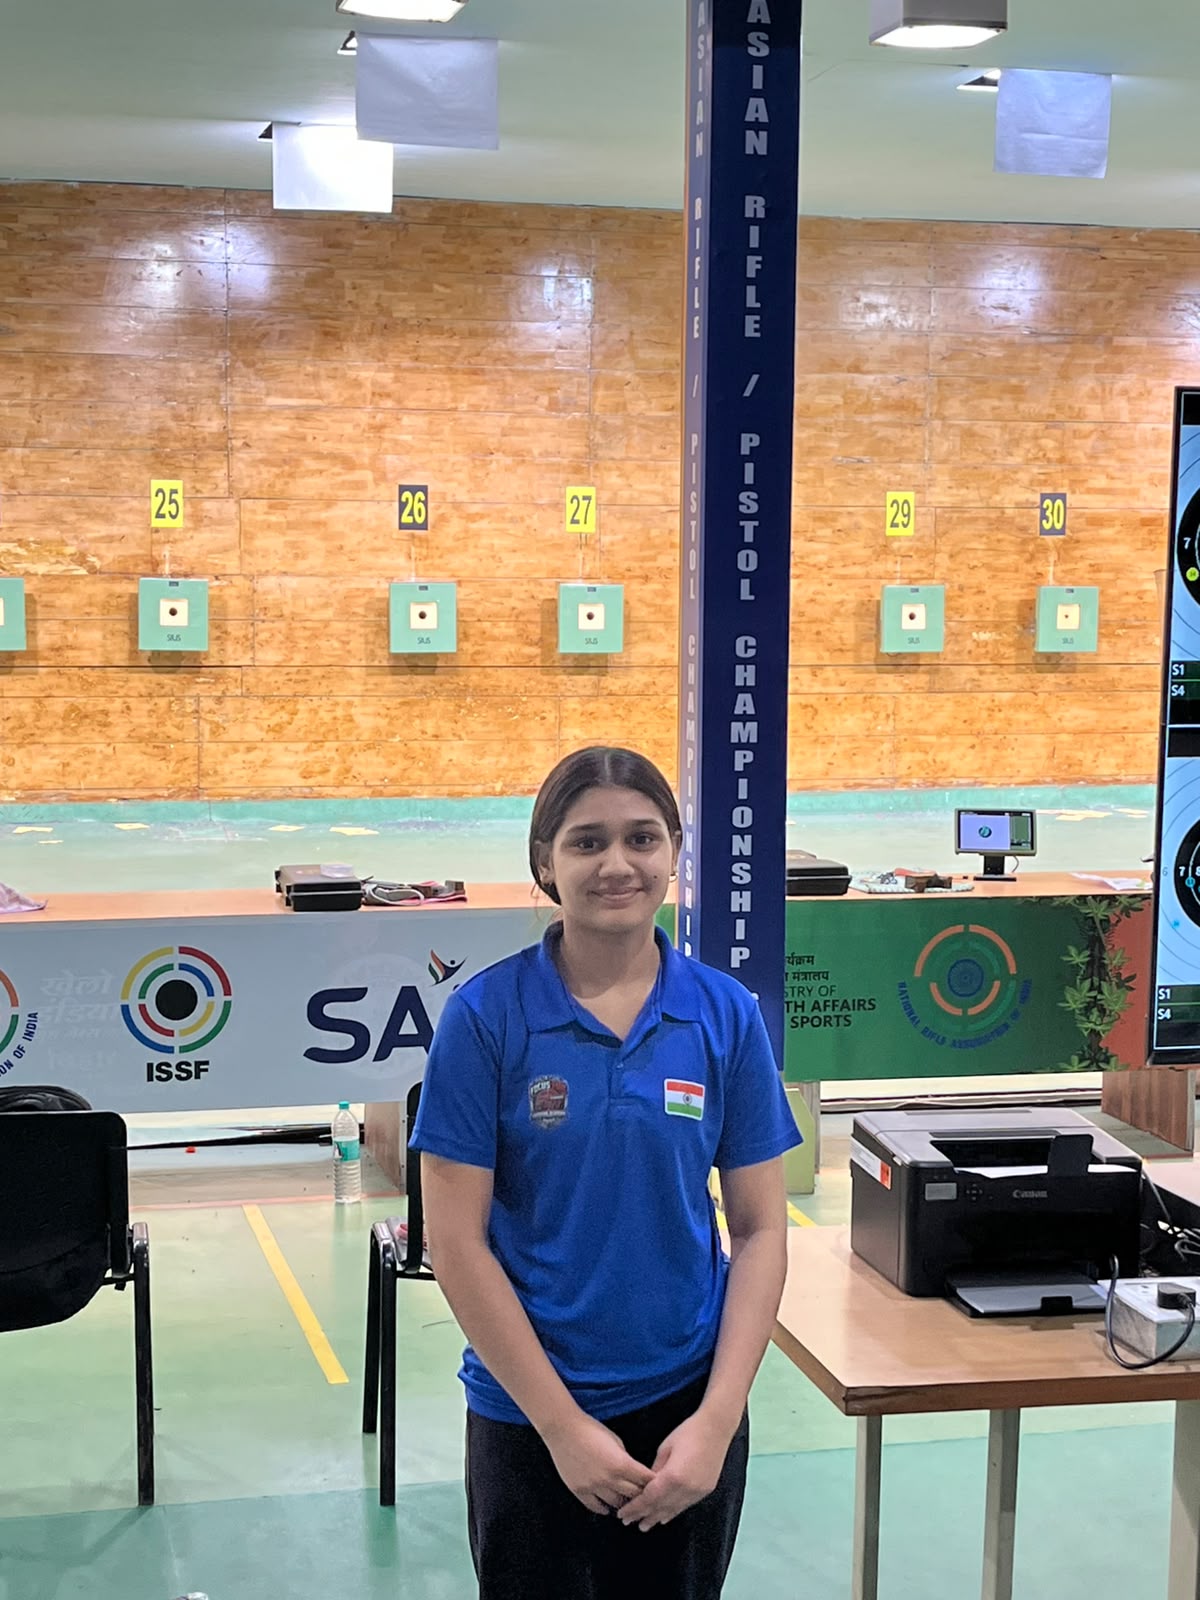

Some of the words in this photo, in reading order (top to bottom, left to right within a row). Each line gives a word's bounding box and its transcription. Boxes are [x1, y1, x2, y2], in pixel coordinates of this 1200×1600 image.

[695, 1, 706, 158] ASIAN
[744, 0, 771, 155] ASIAN
[693, 196, 702, 339] RIFLE
[744, 195, 766, 338] RIFLE
[742, 374, 760, 397] /
[154, 488, 180, 520] 25
[400, 491, 426, 524] 26
[569, 495, 592, 525] 27
[689, 433, 698, 600] PISTOL
[737, 433, 761, 601] PISTOL
[889, 499, 912, 528] 29
[1041, 498, 1065, 530] 30
[1183, 537, 1192, 550] 7
[1171, 664, 1185, 676] S1
[1171, 685, 1186, 697] S4
[730, 635, 758, 969] CHAMPIONSHIP
[1178, 866, 1186, 877] 7
[811, 998, 877, 1013] AFFAIRS
[817, 984, 838, 998] OF
[1158, 988, 1171, 1000] S1
[790, 1014, 853, 1030] SPORTS
[1157, 1008, 1172, 1021] S4
[13, 1044, 26, 1059] OF
[22, 1012, 39, 1041] INDIA
[146, 1060, 210, 1083] ISSF
